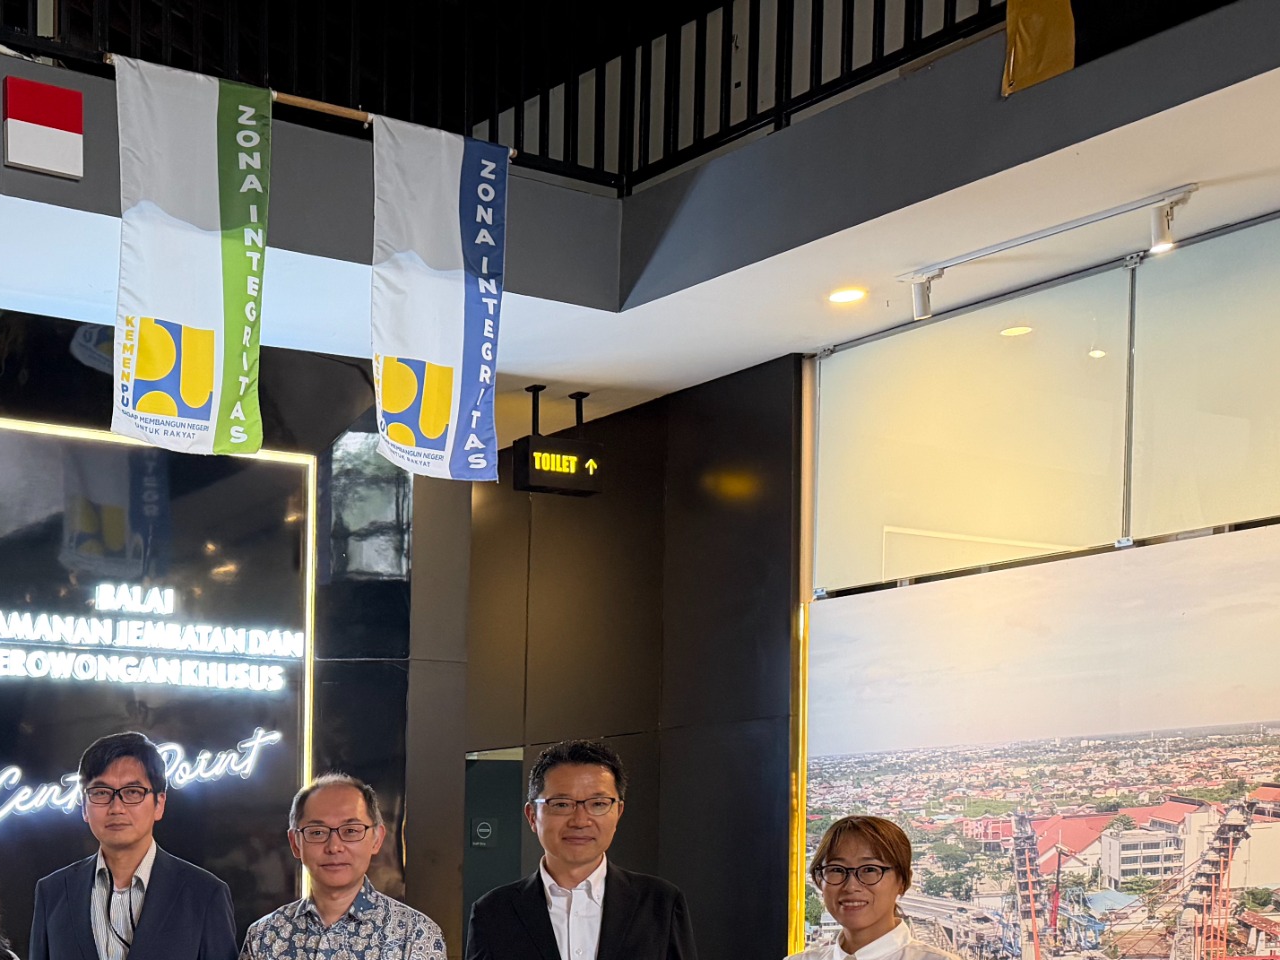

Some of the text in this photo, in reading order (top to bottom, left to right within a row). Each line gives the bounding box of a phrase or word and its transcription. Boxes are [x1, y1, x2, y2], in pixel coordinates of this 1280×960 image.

[230, 104, 263, 444] ZONA INTEGRITAS
[464, 158, 498, 469] ZONA INTEGRITAS
[139, 416, 186, 429] MEMBANGUN
[186, 423, 209, 432] NEGERI
[163, 430, 196, 439] RAKYAT
[533, 452, 578, 474] TOILET
[96, 583, 175, 614] BALAI
[113, 620, 248, 654] JEMBATAN
[248, 628, 305, 657] DAN
[180, 659, 286, 692] KHUSUS
